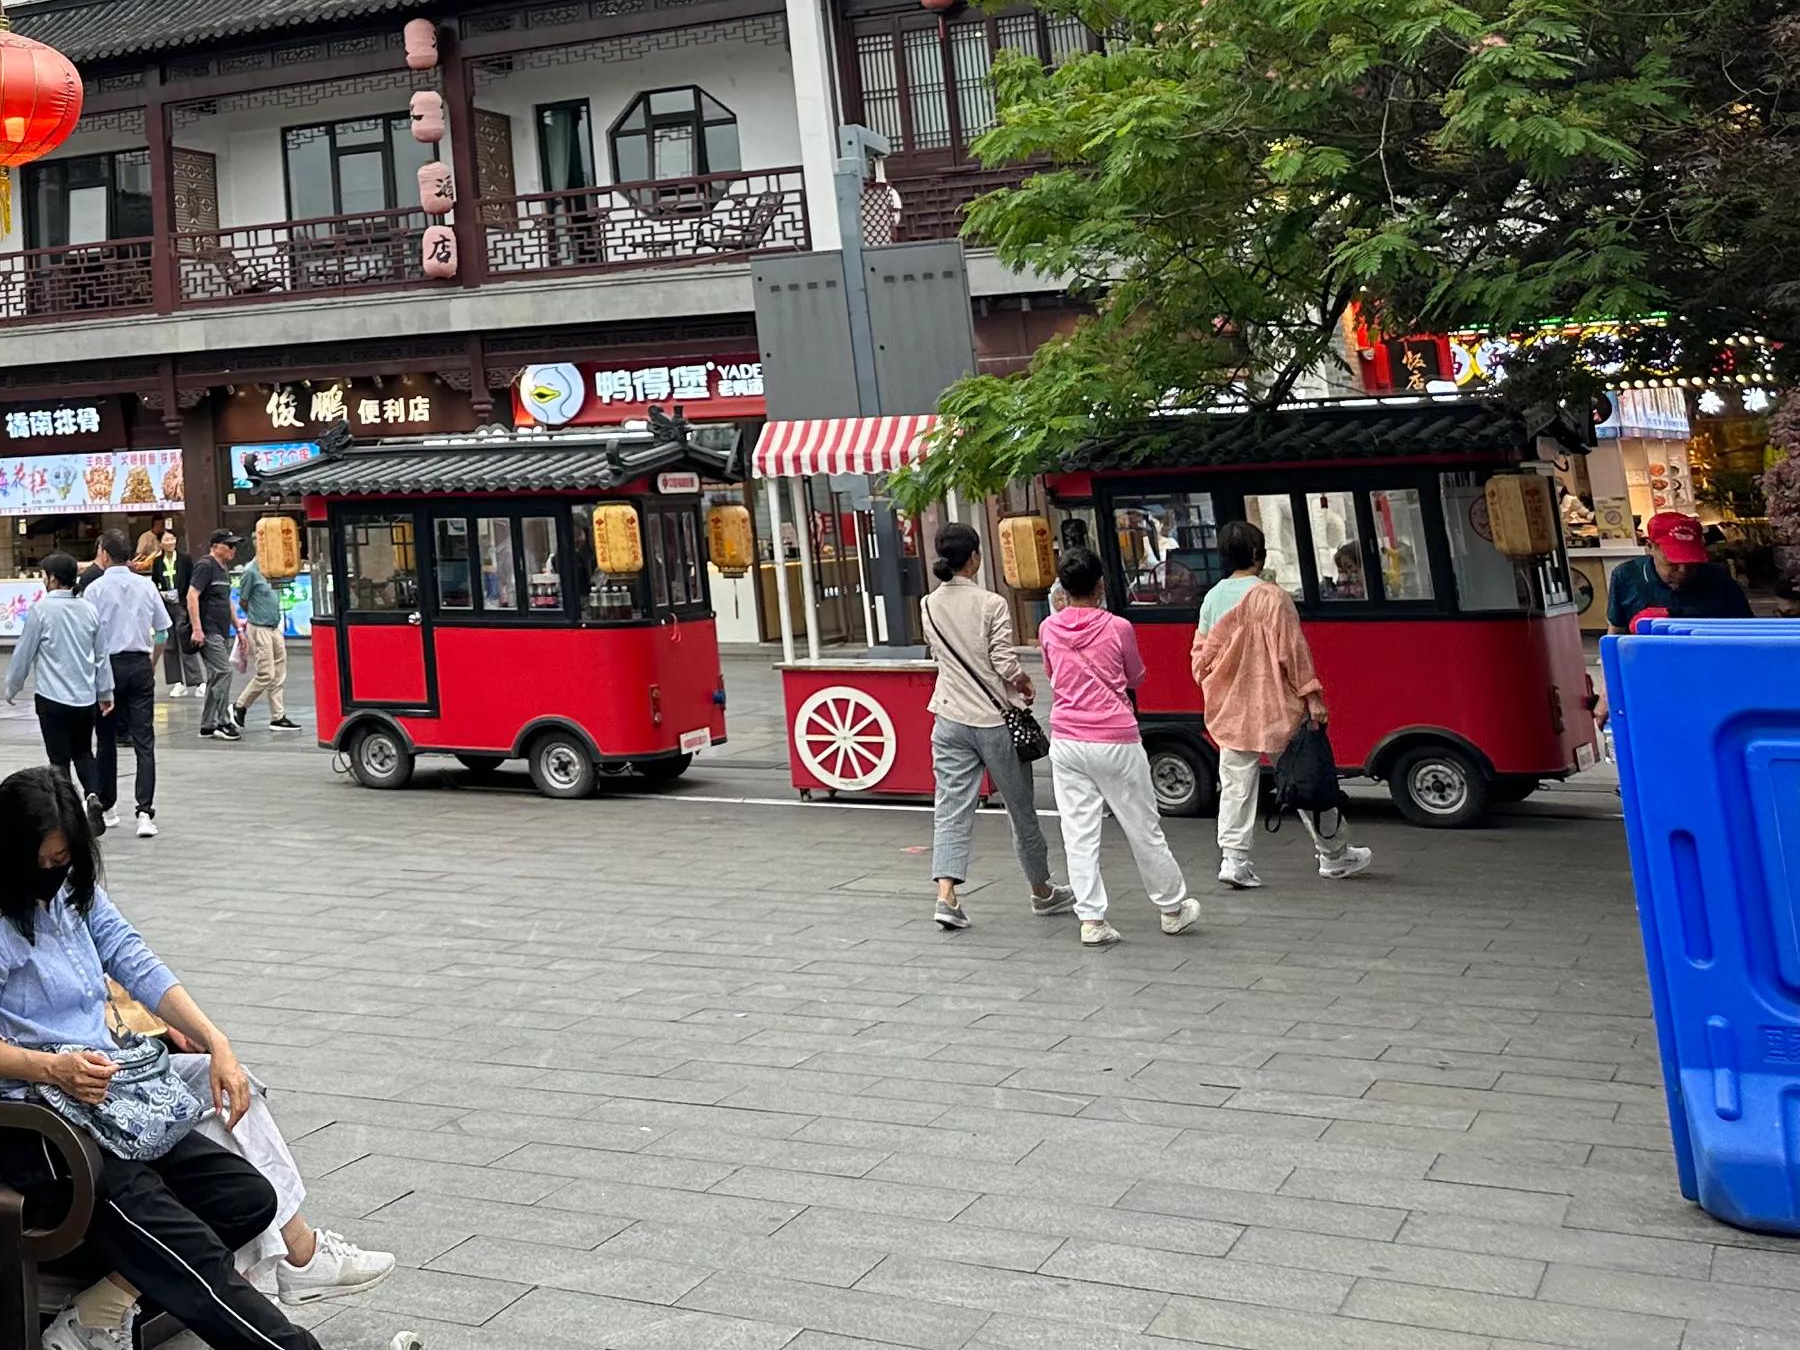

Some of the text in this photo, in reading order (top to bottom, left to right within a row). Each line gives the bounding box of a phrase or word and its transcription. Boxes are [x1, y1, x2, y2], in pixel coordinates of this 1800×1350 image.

[595, 364, 710, 404] 鸭得堡
[265, 383, 431, 429] 俊鹏 便利店
